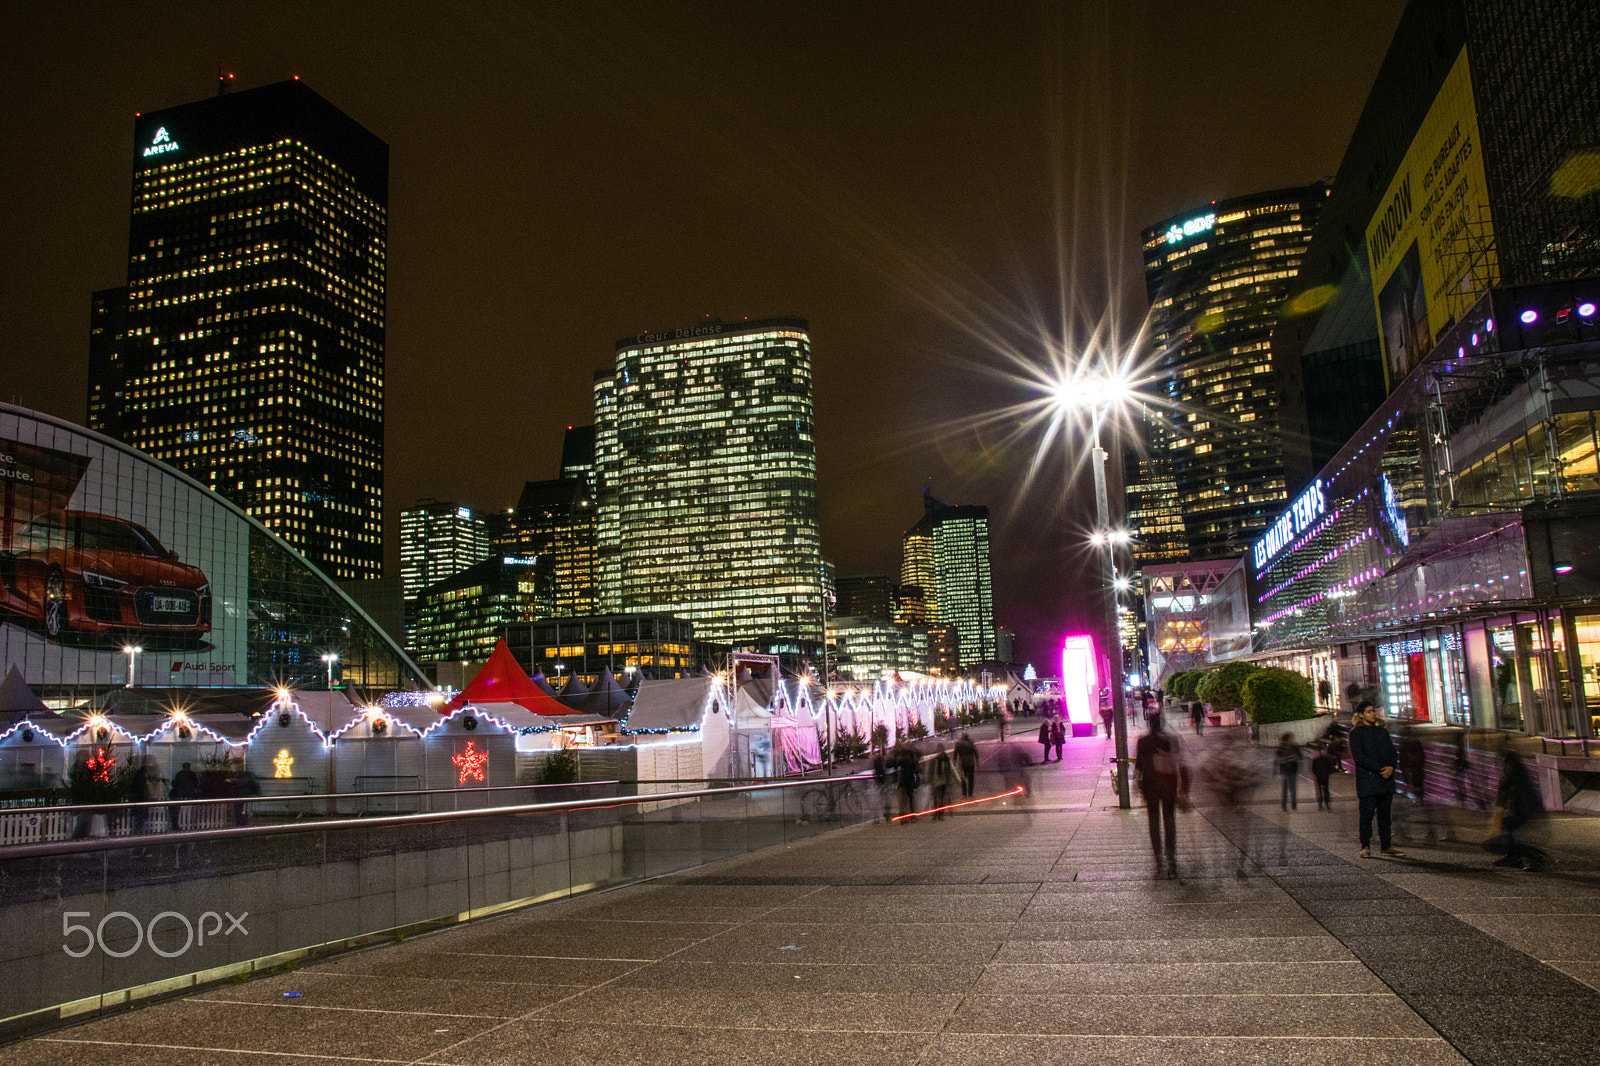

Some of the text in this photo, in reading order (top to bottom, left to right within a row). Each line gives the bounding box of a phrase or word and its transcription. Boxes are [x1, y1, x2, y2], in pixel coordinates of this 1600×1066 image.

[143, 141, 179, 157] AREVA
[1432, 120, 1462, 176] BUREAUX
[1370, 172, 1412, 271] WINDOW
[1254, 538, 1267, 569] LES
[1265, 510, 1294, 559] QUATRE
[1292, 478, 1325, 533] TEMPS
[184, 662, 236, 672] Audi Sport
